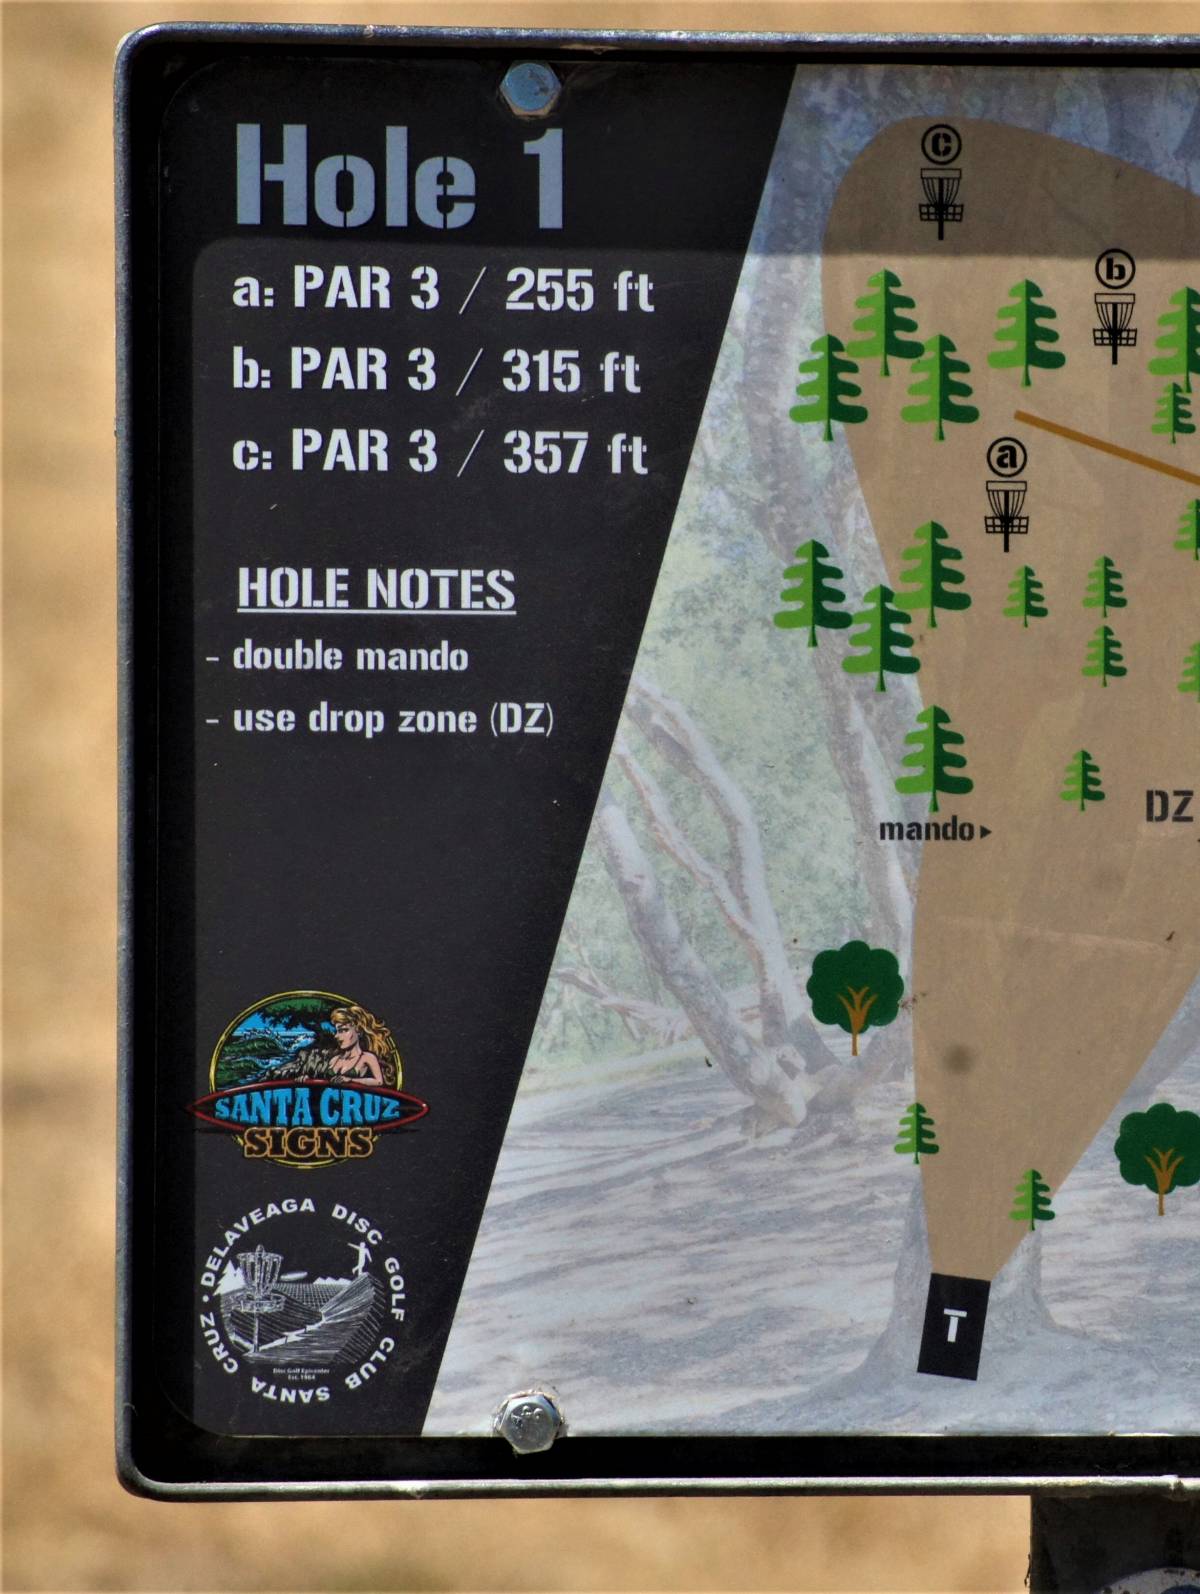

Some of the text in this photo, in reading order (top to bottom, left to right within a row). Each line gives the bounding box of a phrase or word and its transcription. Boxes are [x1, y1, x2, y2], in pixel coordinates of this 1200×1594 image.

[237, 124, 562, 228] Hole 1
[233, 265, 654, 314] a: PAR 3 / 255 ft
[234, 346, 640, 396] b: PAR 3 / 315 ft
[233, 429, 648, 477] c: PAR 3 / 357 ft
[996, 444, 1018, 469] a
[237, 566, 517, 611] HOLE NOTES
[234, 639, 342, 669] double
[357, 640, 468, 670] mando
[234, 710, 295, 731] use
[309, 701, 384, 738] drop
[398, 711, 477, 732] zone
[491, 703, 553, 736] (DZ)
[1146, 790, 1193, 822] DZ
[879, 814, 975, 842] mando
[214, 1087, 401, 1127] SANTA CRUZ
[243, 1126, 374, 1158] SIGNS
[200, 1197, 406, 1404] DELAVEAGA DISC GOLF CLUB SANTA CRUZ
[944, 1309, 967, 1342] T
